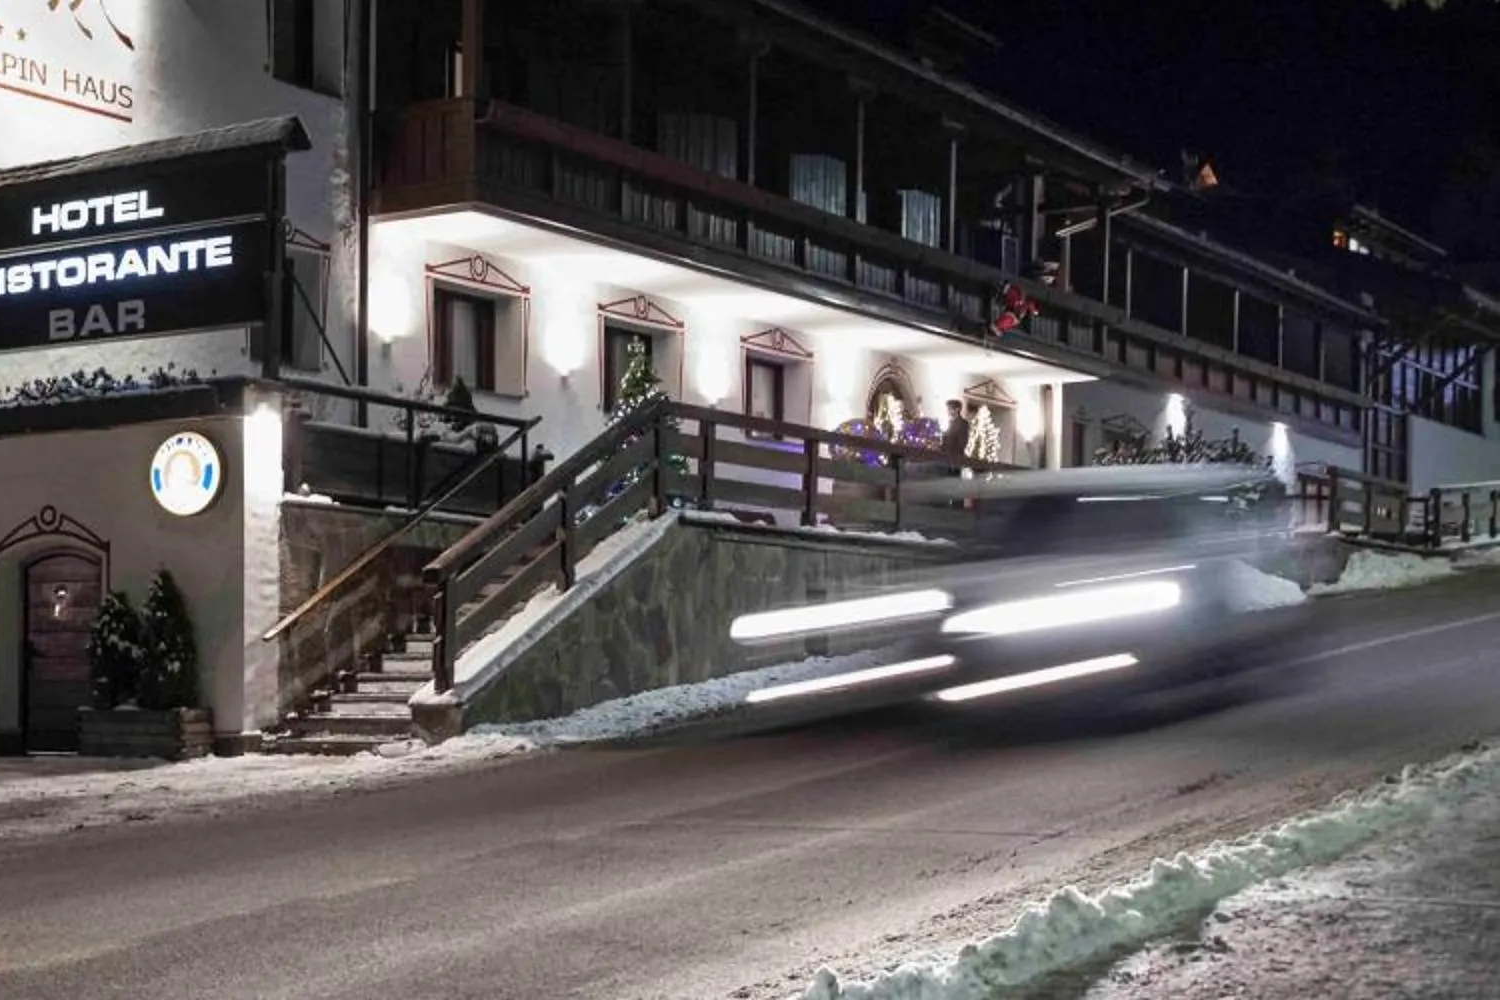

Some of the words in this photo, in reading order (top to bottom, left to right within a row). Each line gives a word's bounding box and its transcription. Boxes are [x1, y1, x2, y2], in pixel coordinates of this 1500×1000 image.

[63, 68, 133, 109] HAUS
[32, 190, 164, 234] HOTEL
[49, 300, 145, 340] BAR
